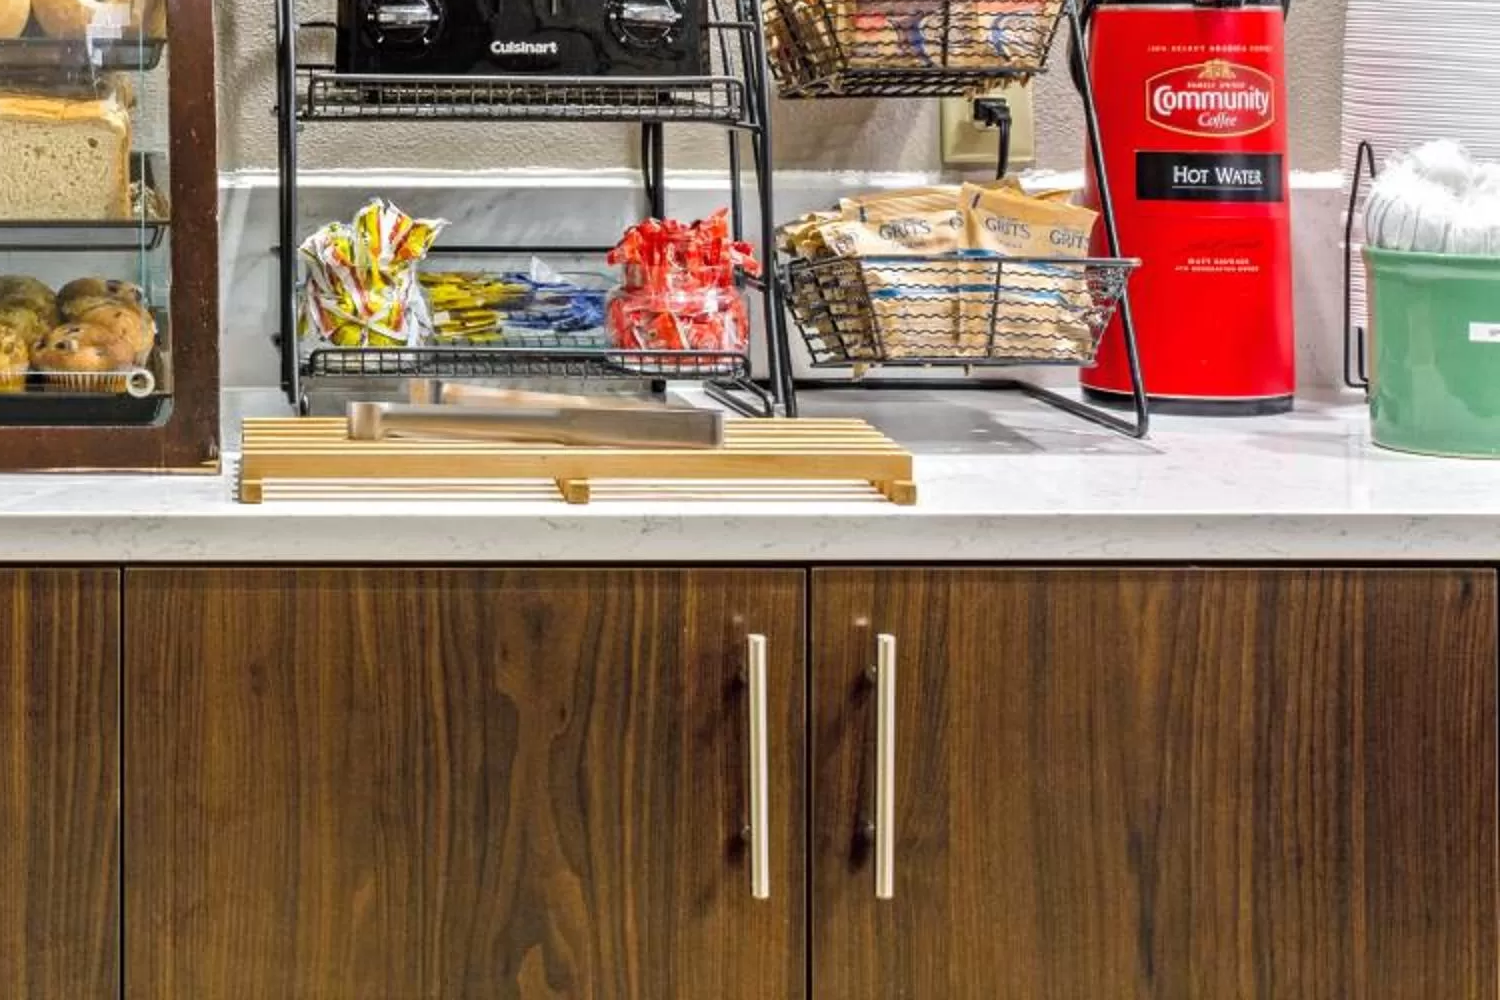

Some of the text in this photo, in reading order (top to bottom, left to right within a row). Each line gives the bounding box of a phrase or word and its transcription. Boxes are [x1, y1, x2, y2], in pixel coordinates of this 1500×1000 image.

[490, 40, 557, 54] Cuisinart
[1153, 84, 1269, 117] Community
[1197, 112, 1238, 128] Coffee
[1173, 165, 1263, 185] HOT WATER
[878, 218, 932, 241] GRITS
[984, 216, 1031, 240] GRITS
